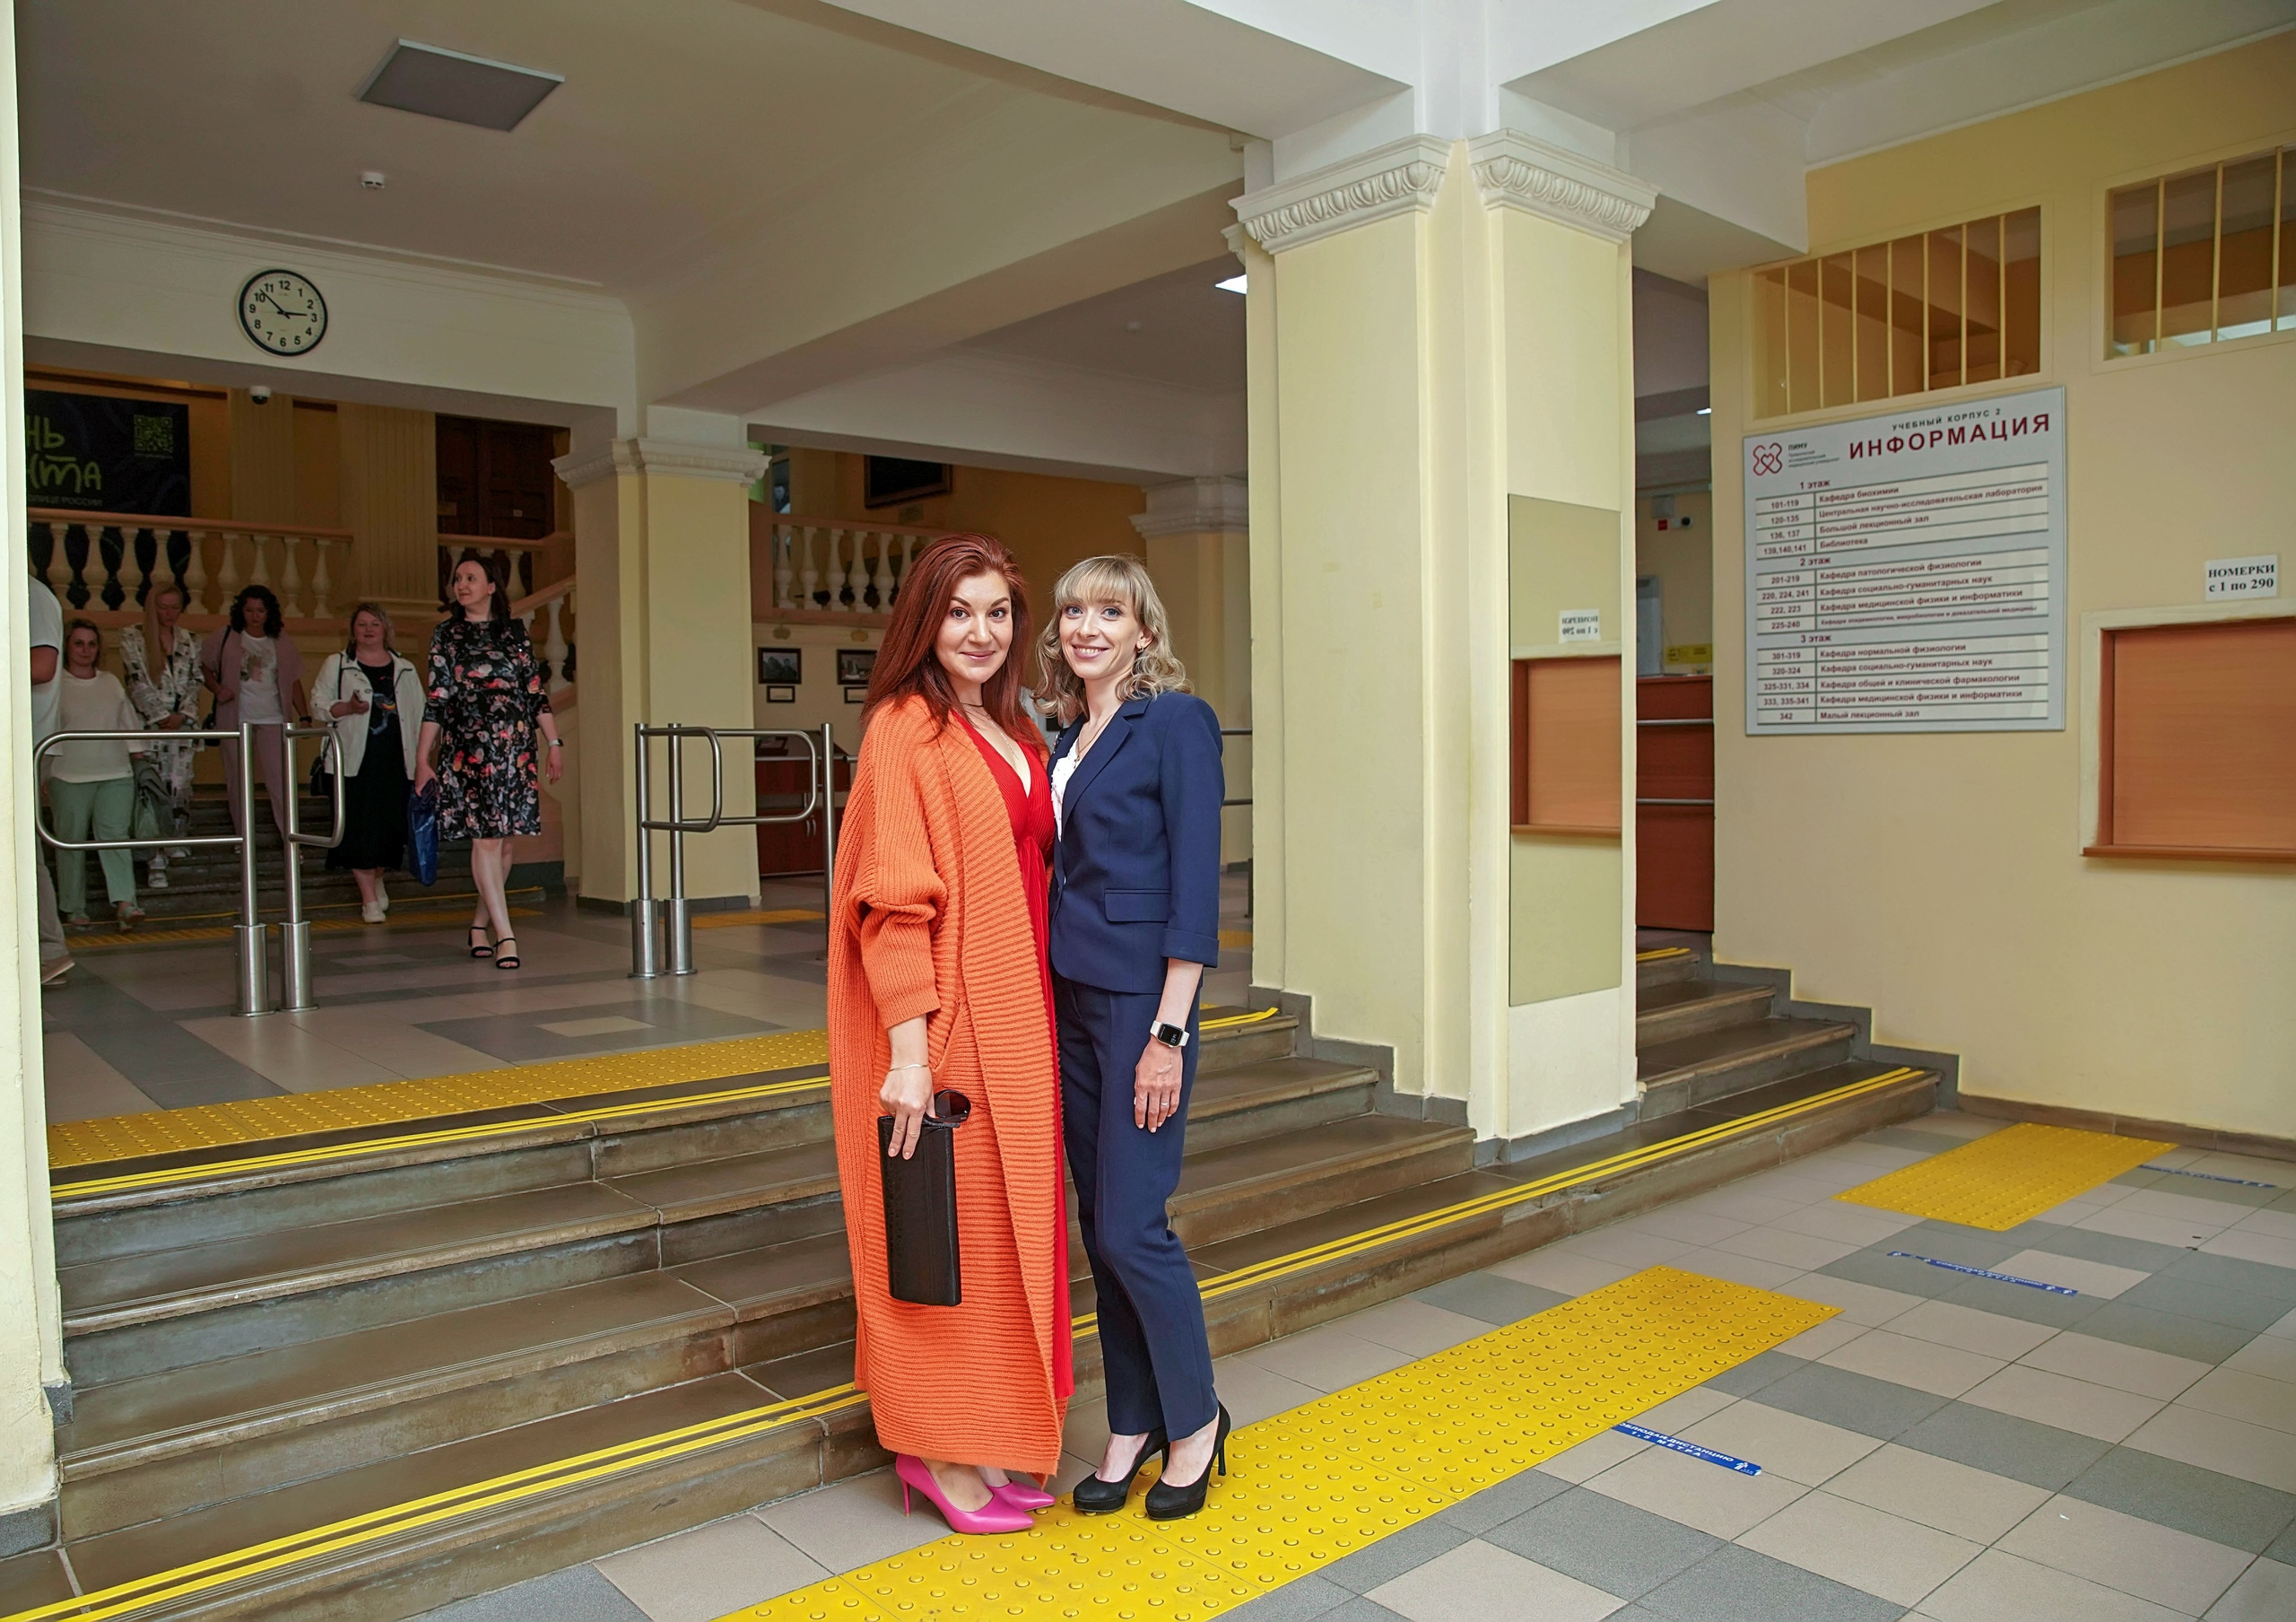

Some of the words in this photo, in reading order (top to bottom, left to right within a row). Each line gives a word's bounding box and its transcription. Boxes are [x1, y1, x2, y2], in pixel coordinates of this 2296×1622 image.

[264, 283, 274, 293] 11
[278, 280, 291, 291] 12
[254, 292, 265, 302] 10
[298, 288, 303, 298] 1
[248, 304, 256, 313] 9
[307, 300, 314, 310] 2
[310, 313, 317, 323] 3
[254, 319, 261, 329] 8
[265, 331, 273, 341] 7
[305, 327, 312, 336] 4
[280, 337, 287, 347] 6
[294, 336, 301, 344] 5
[1892, 418, 1942, 432] УЧЕБНЫЙ
[1947, 409, 1990, 423] КОРПУС
[1849, 413, 2049, 460] ИНФОРМАЦИЯ
[1807, 480, 1831, 489] этаж
[1819, 493, 1855, 503] Кафедра
[1857, 487, 1899, 499] биохимии
[1771, 500, 1799, 509] 101-119
[1819, 506, 1869, 519] Центральная
[1871, 493, 1983, 512] научно-исследовательская
[1986, 484, 2042, 498] лаборатория
[1771, 515, 1799, 524] 120-135
[1820, 523, 1857, 534] Большой
[1859, 517, 1912, 528] лекционный
[1787, 530, 1800, 538] 137
[1820, 538, 1867, 549] Библиотека
[1800, 558, 1805, 566] 2
[1808, 557, 1831, 565] этаж
[1820, 571, 1856, 580] Кафедра
[1858, 563, 1925, 577] патологической
[1927, 560, 1982, 571] физиологии
[2208, 564, 2274, 578] НОМЕРКИ
[1771, 575, 1800, 584] 201-219
[2221, 581, 2225, 591] 1
[2231, 582, 2247, 590] по
[2250, 578, 2274, 589] 290
[1820, 587, 1856, 597] Кафедра
[1857, 578, 1970, 594] социально-гуманитарных
[1971, 576, 1993, 584] наук
[1796, 589, 1809, 597] 241
[1820, 603, 1856, 612] Кафедра
[1858, 597, 1914, 609] медицинской
[1917, 596, 1949, 606] физики
[1960, 590, 2022, 601] информатики
[2002, 606, 2037, 614] медицины
[1771, 621, 1800, 629] 225-240
[1809, 634, 1831, 642] этаж
[1772, 651, 1801, 660] 301-319
[1820, 649, 1856, 658] Кафедра
[1857, 648, 1910, 657] нормальной
[1912, 644, 1966, 654] физиологии
[1821, 664, 1857, 673] Кафедра
[1858, 660, 1970, 672] социально-гуманитарных
[1972, 658, 1993, 667] наук
[1772, 667, 1801, 676] 320-324
[1820, 680, 1857, 690] Кафедра
[1858, 679, 1884, 687] общей
[1895, 676, 1951, 686] клинической
[1952, 675, 2020, 685] фармакологии
[1780, 697, 1809, 705] 335-341
[1820, 695, 1856, 704] Кафедра
[1858, 694, 1914, 704] медицинской
[1916, 693, 1949, 702] физики
[1960, 690, 2022, 701] информатики
[1779, 712, 1793, 720] 342
[1820, 711, 1848, 719] Малый
[1850, 711, 1902, 719] лекционный
[1631, 1431, 1651, 1439] 1,5
[1656, 1439, 1701, 1457] МЕТРА
[1666, 1437, 1735, 1461] ДИСТАНЦИЮ
